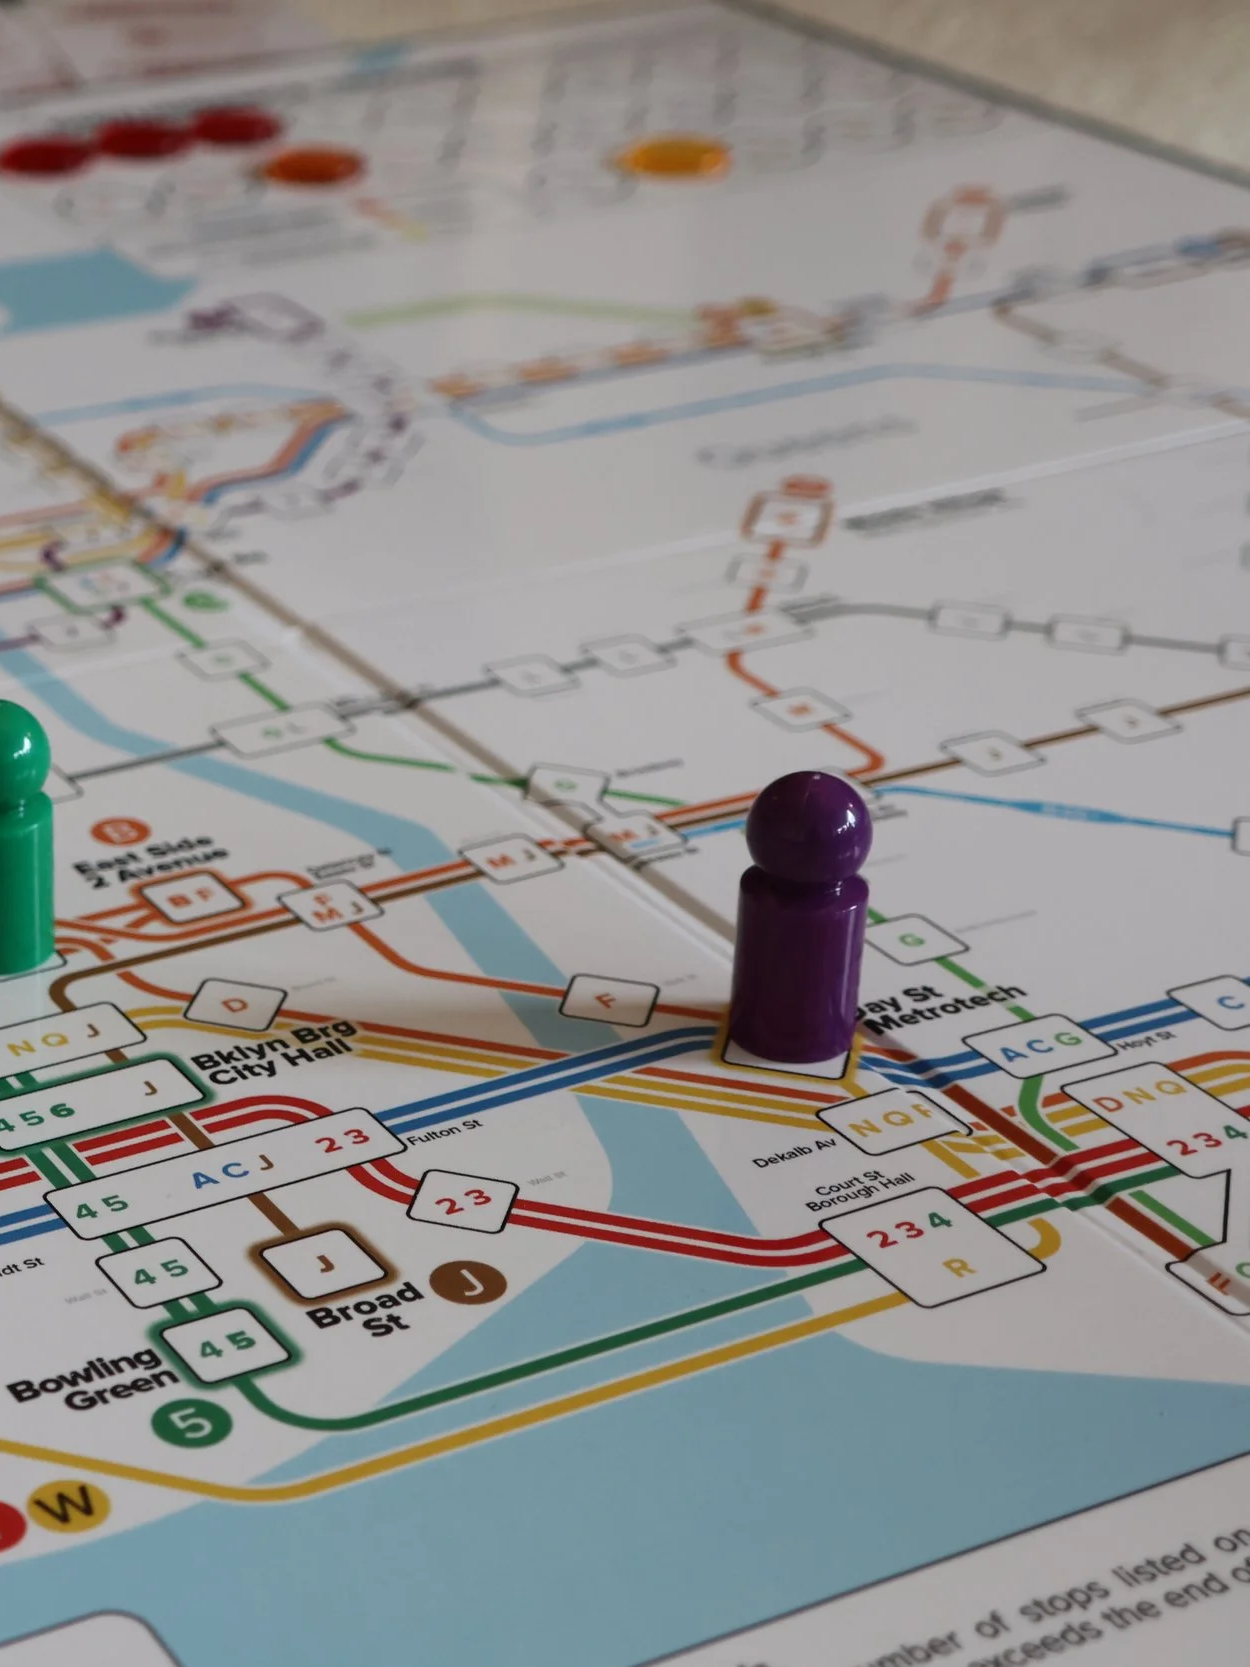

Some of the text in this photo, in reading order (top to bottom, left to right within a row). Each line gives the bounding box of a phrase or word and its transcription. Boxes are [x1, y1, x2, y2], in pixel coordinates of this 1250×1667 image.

[72, 836, 214, 878] East Side
[91, 849, 230, 890] 2 Avenue
[898, 933, 925, 947] G
[222, 999, 249, 1014] D
[594, 992, 616, 1009] F
[902, 985, 944, 1002] St
[1216, 995, 1246, 1011] C
[863, 985, 1028, 1036] Metrotech
[191, 1020, 358, 1071] Bklyn Brg
[209, 1038, 353, 1085] City Hall
[142, 1080, 159, 1097] J
[406, 1119, 484, 1147] Fulton St
[752, 1136, 836, 1170] Dekalb Av
[805, 1172, 916, 1213] Borough Hall
[814, 1168, 885, 1197] Court St
[24, 1255, 46, 1271] St
[315, 1253, 336, 1274] J
[941, 1258, 977, 1279] R
[458, 1269, 485, 1297] J
[305, 1282, 425, 1330] Broad
[361, 1312, 410, 1339] St
[6, 1347, 164, 1404] Bowling
[63, 1365, 180, 1412] Green
[168, 1408, 208, 1440] 5
[33, 1483, 95, 1526] W
[974, 1610, 1011, 1640] of
[1019, 1579, 1110, 1623] stops
[1111, 1542, 1207, 1588] listed
[1101, 1600, 1162, 1630] the
[1163, 1571, 1230, 1608] end
